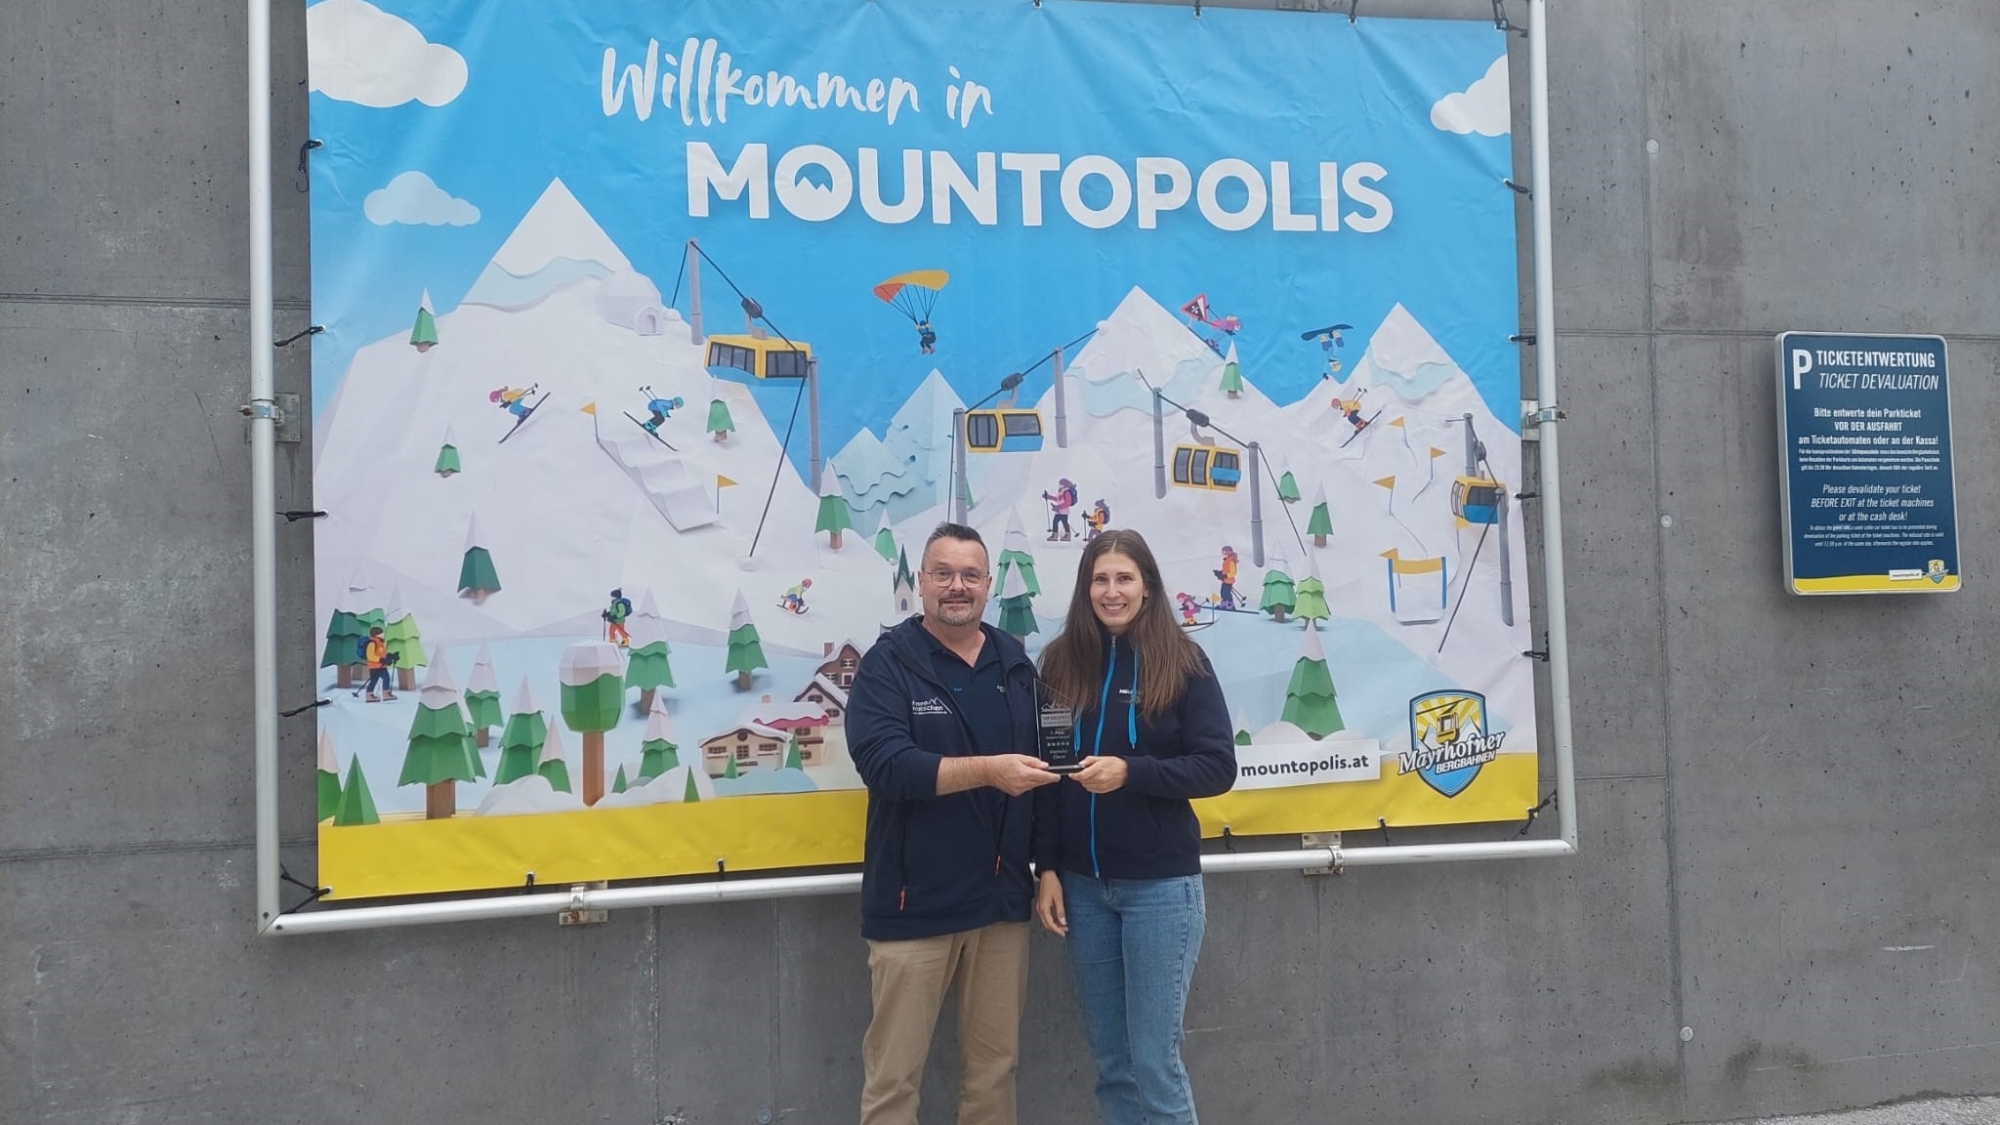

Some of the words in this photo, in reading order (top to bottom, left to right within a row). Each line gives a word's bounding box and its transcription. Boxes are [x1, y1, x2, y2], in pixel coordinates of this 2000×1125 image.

[602, 37, 920, 127] Willkommen
[946, 65, 994, 129] in
[686, 141, 1394, 234] MOUNTOPOLIS
[1816, 350, 1936, 368] TICKETENTWERTUNG
[1792, 349, 1813, 390] P
[1819, 372, 1859, 389] TICKET
[1861, 374, 1939, 390] DEVALUATION
[1814, 407, 1831, 418] Bitte
[1833, 408, 1865, 418] entwerte
[1866, 408, 1882, 418] dein
[1884, 408, 1921, 418] Parkticket
[1834, 421, 1849, 431] VOR
[1850, 421, 1865, 431] DER
[1867, 421, 1902, 431] AUSFAHRT
[1798, 436, 1810, 444] am
[1811, 434, 1871, 445] Ticketautomaten
[1873, 435, 1889, 445] oder
[1891, 437, 1900, 445] an
[1902, 435, 1914, 445] der
[1915, 435, 1939, 445] Kassa!
[1822, 484, 1846, 494] Please
[1847, 484, 1884, 494] devalidate
[1885, 485, 1900, 496] your
[1901, 484, 1921, 494] ticket
[1811, 497, 1839, 508] BEFORE
[1840, 497, 1857, 507] EXIT
[1857, 498, 1865, 507] at
[1866, 498, 1878, 507] the
[1880, 498, 1899, 507] ticket
[1901, 498, 1934, 508] machines
[1839, 513, 1847, 521] or
[1848, 512, 1856, 521] at
[1857, 511, 1868, 521] the
[1870, 511, 1887, 521] cash
[1888, 511, 1908, 521] desk!
[1398, 731, 1506, 775] Mayrhofner
[1240, 755, 1369, 777] mountopolis.at
[1436, 751, 1495, 774] BERGBAHNEN
